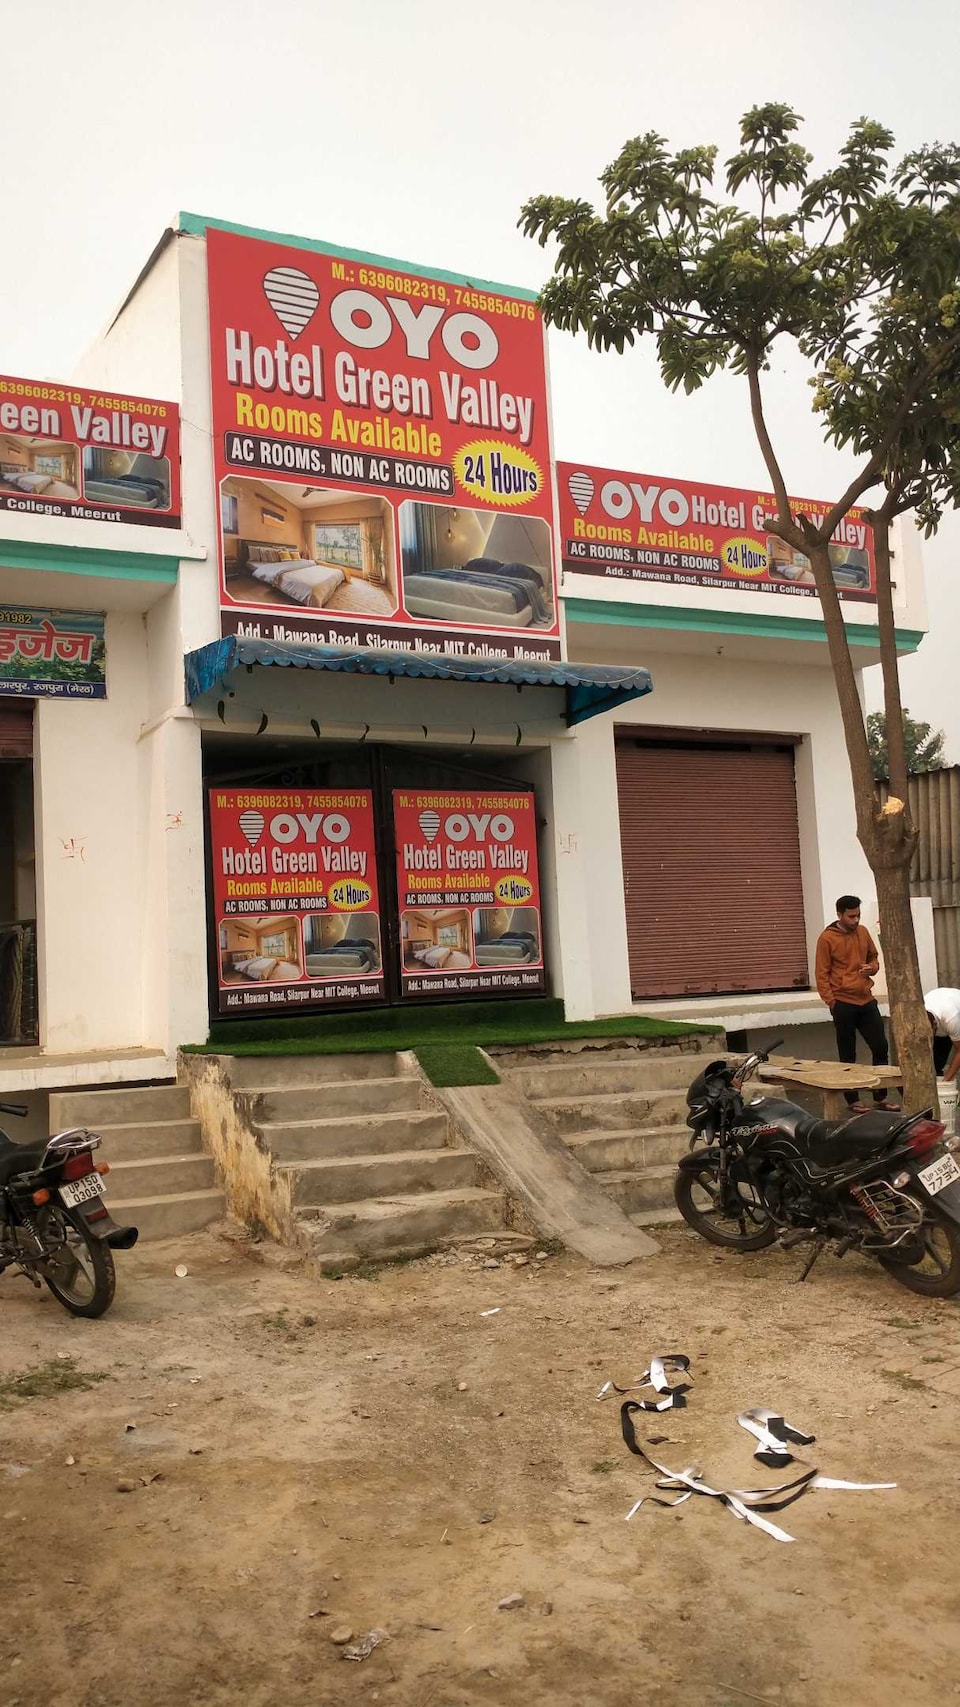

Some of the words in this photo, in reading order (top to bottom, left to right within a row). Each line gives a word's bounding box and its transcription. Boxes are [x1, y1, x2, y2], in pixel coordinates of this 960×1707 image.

[332, 262, 354, 282] M.:
[359, 269, 450, 304] 6396082319,
[454, 290, 535, 320] 7455854076
[329, 289, 499, 370] OYO
[0, 381, 85, 407] 6396082319,
[89, 395, 166, 417] 7455854076
[225, 328, 322, 398] Hotel
[335, 351, 430, 416] Green
[439, 371, 534, 445] Valley
[71, 405, 166, 457] Valley
[236, 392, 322, 438] Rooms
[331, 409, 442, 457] Available
[231, 437, 254, 462] AC
[260, 441, 326, 473] ROOMS,
[331, 453, 365, 478] NON
[369, 460, 390, 482] AC
[395, 465, 450, 491] ROOMS
[464, 455, 486, 487] 24
[490, 452, 538, 494] Hours
[7, 499, 66, 516] College,
[71, 506, 121, 521] Meerut
[600, 480, 689, 527] OYO
[692, 495, 746, 529] Hotel
[573, 518, 632, 543] Rooms
[637, 526, 715, 553] Available
[570, 542, 586, 557] AC
[590, 544, 634, 562] ROOMS,
[637, 551, 660, 565] NON
[664, 554, 678, 566] AC
[681, 555, 720, 571] ROOMS
[726, 547, 739, 565] 24
[741, 544, 767, 569] Hours
[605, 566, 629, 577] Add.:
[632, 569, 671, 581] Mawana
[674, 573, 699, 585] Road,
[702, 576, 737, 589] Silarpur
[739, 581, 759, 590] Near
[761, 582, 777, 591] MIT
[779, 584, 813, 596] College,
[444, 640, 465, 655] MIT
[217, 796, 234, 808] M.:
[237, 795, 304, 810] 6396082319,
[307, 796, 367, 808] 7455854076
[400, 796, 414, 808] M.:
[416, 796, 475, 810] 6396082319,
[477, 797, 529, 809] 7455854076
[270, 813, 350, 844] OYO
[444, 813, 515, 842] OYO
[222, 847, 267, 875] Hotel
[271, 847, 317, 874] Green
[321, 846, 367, 877] Valley
[404, 843, 442, 870] Hotel
[446, 843, 485, 869] Green
[488, 844, 529, 873] Valley
[227, 880, 267, 896] Rooms
[270, 877, 323, 895] Available
[333, 889, 344, 902] 24
[346, 884, 369, 904] Hours
[408, 874, 442, 889] Rooms
[444, 873, 490, 889] Available
[499, 884, 509, 897] 24
[510, 880, 531, 900] Hours
[225, 901, 236, 912] AC
[238, 900, 268, 912] ROOMS,
[270, 899, 287, 910] NON
[288, 898, 299, 909] AC
[300, 897, 327, 909] ROOMS
[406, 894, 416, 905] AC
[445, 893, 459, 904] NON
[460, 892, 469, 903] AC
[470, 892, 494, 903] ROOMS
[244, 992, 268, 1004] Mawana
[270, 991, 286, 1003] Road,
[287, 989, 310, 1001] Silarpur
[311, 988, 324, 999] Near
[325, 986, 336, 998] MIT
[337, 984, 360, 997] College,
[360, 983, 380, 995] Meerut
[422, 979, 443, 990] Mawana
